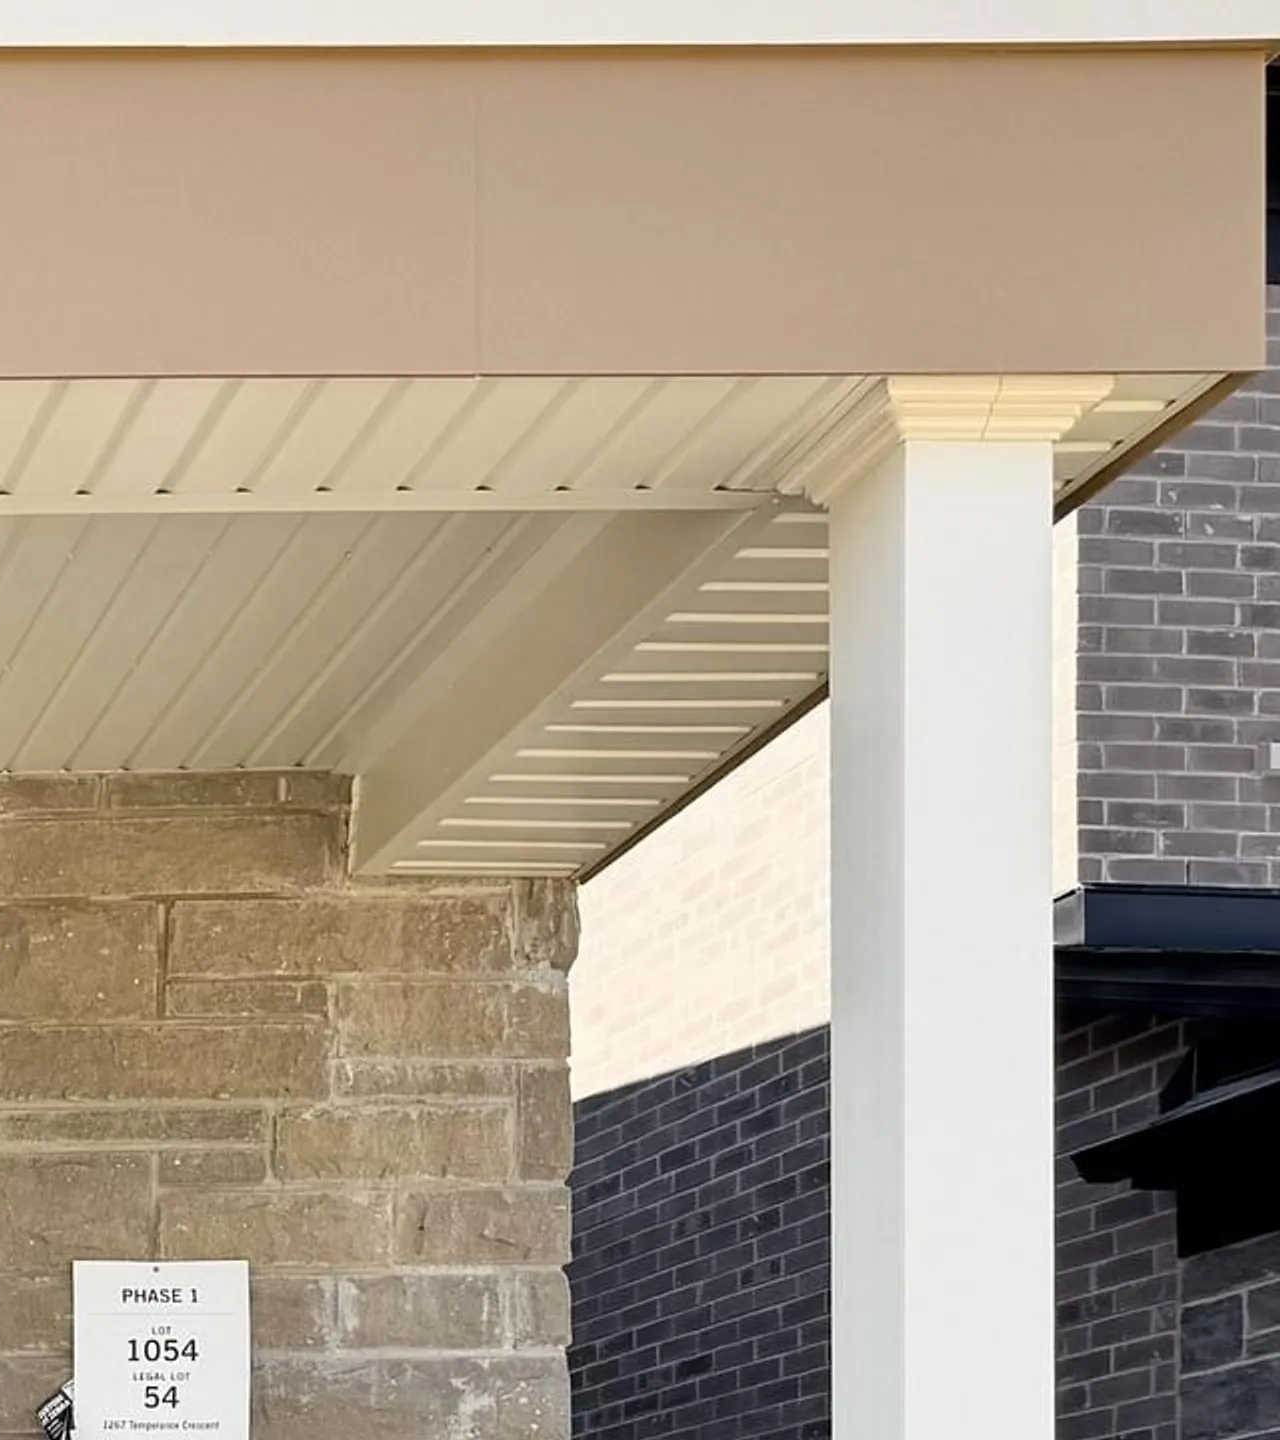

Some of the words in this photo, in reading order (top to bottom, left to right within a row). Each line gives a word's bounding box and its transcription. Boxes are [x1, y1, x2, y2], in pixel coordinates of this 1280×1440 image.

[122, 1288, 183, 1303] PHASE
[191, 1288, 198, 1303] 1
[151, 1326, 171, 1335] LOT
[128, 1339, 199, 1361] 1054
[132, 1371, 166, 1381] LEGAL
[170, 1371, 191, 1381] LOT
[144, 1386, 180, 1409] 54
[103, 1420, 126, 1430] 1267
